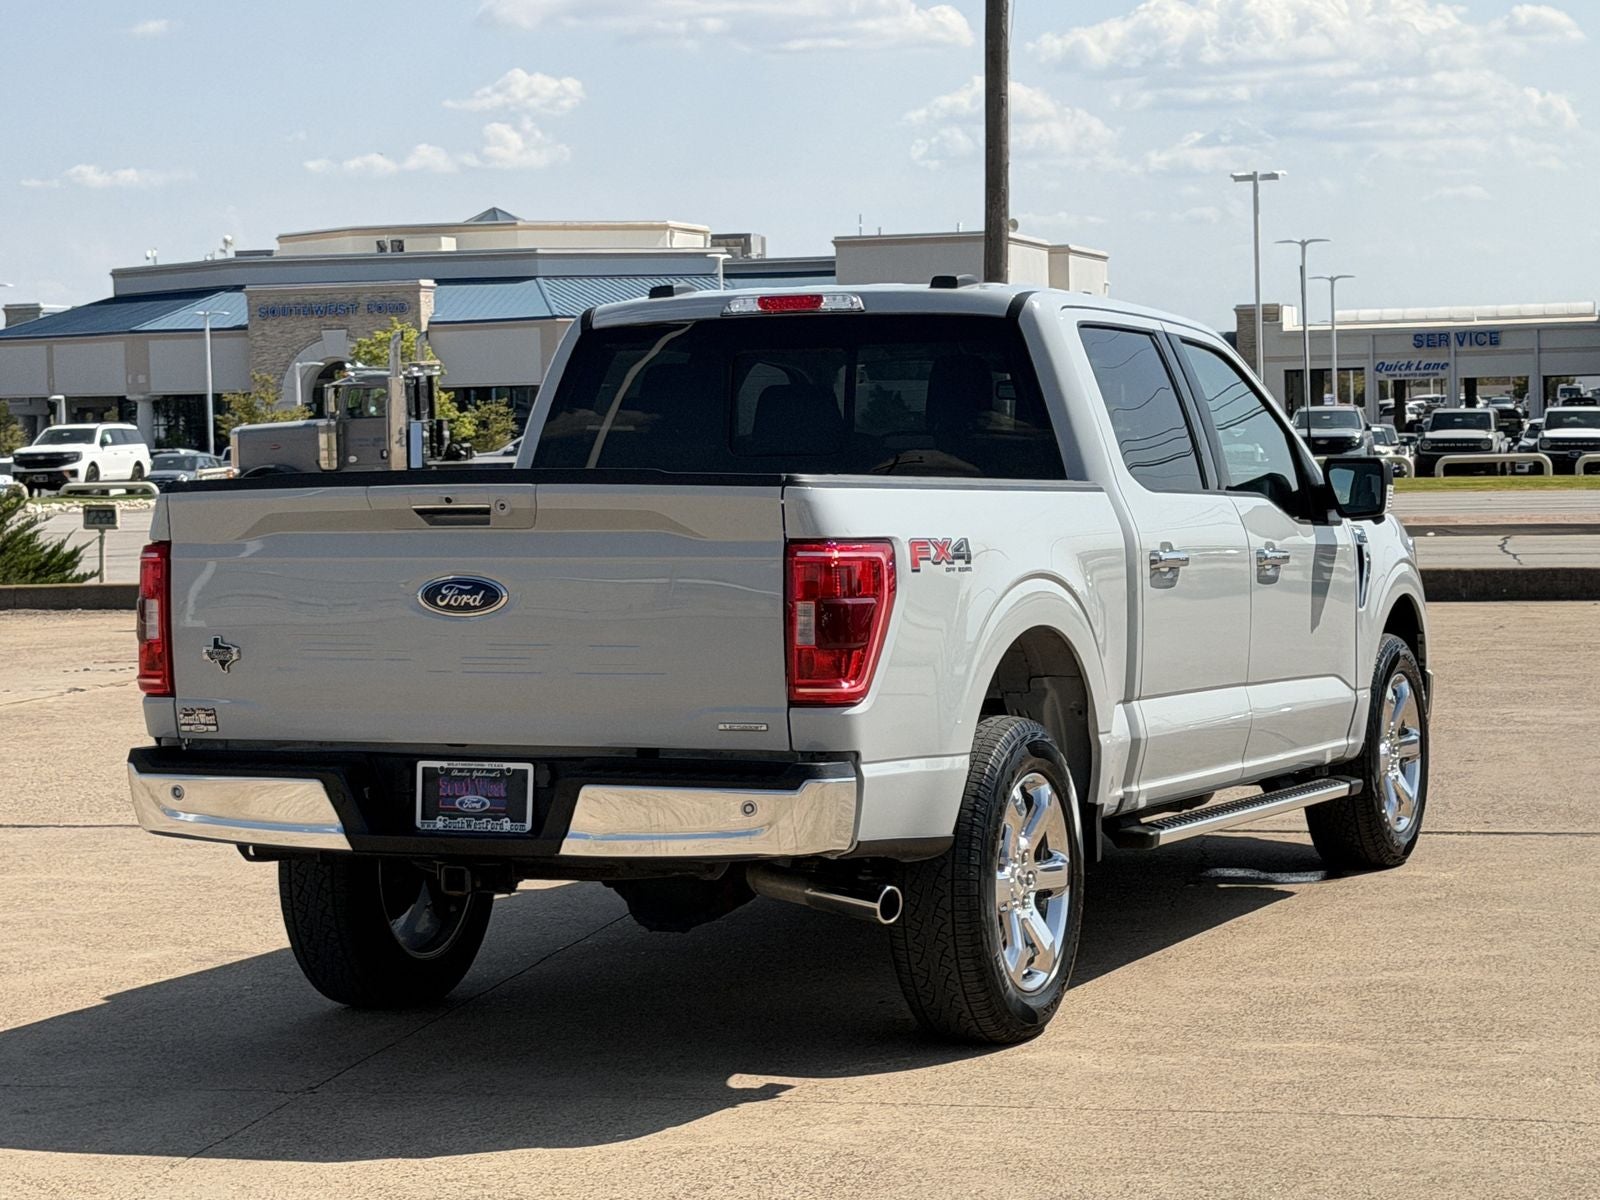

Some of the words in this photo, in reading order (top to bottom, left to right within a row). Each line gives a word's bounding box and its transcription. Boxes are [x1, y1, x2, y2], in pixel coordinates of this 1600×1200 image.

[258, 303, 357, 320] SOUTHWEST
[366, 301, 409, 315] FORD
[1412, 331, 1501, 348] SERVICE
[1375, 361, 1413, 373] Quick
[1414, 360, 1449, 371] Lane
[908, 538, 972, 573] FX4
[436, 583, 485, 607] Ford
[463, 798, 482, 808] Ford
